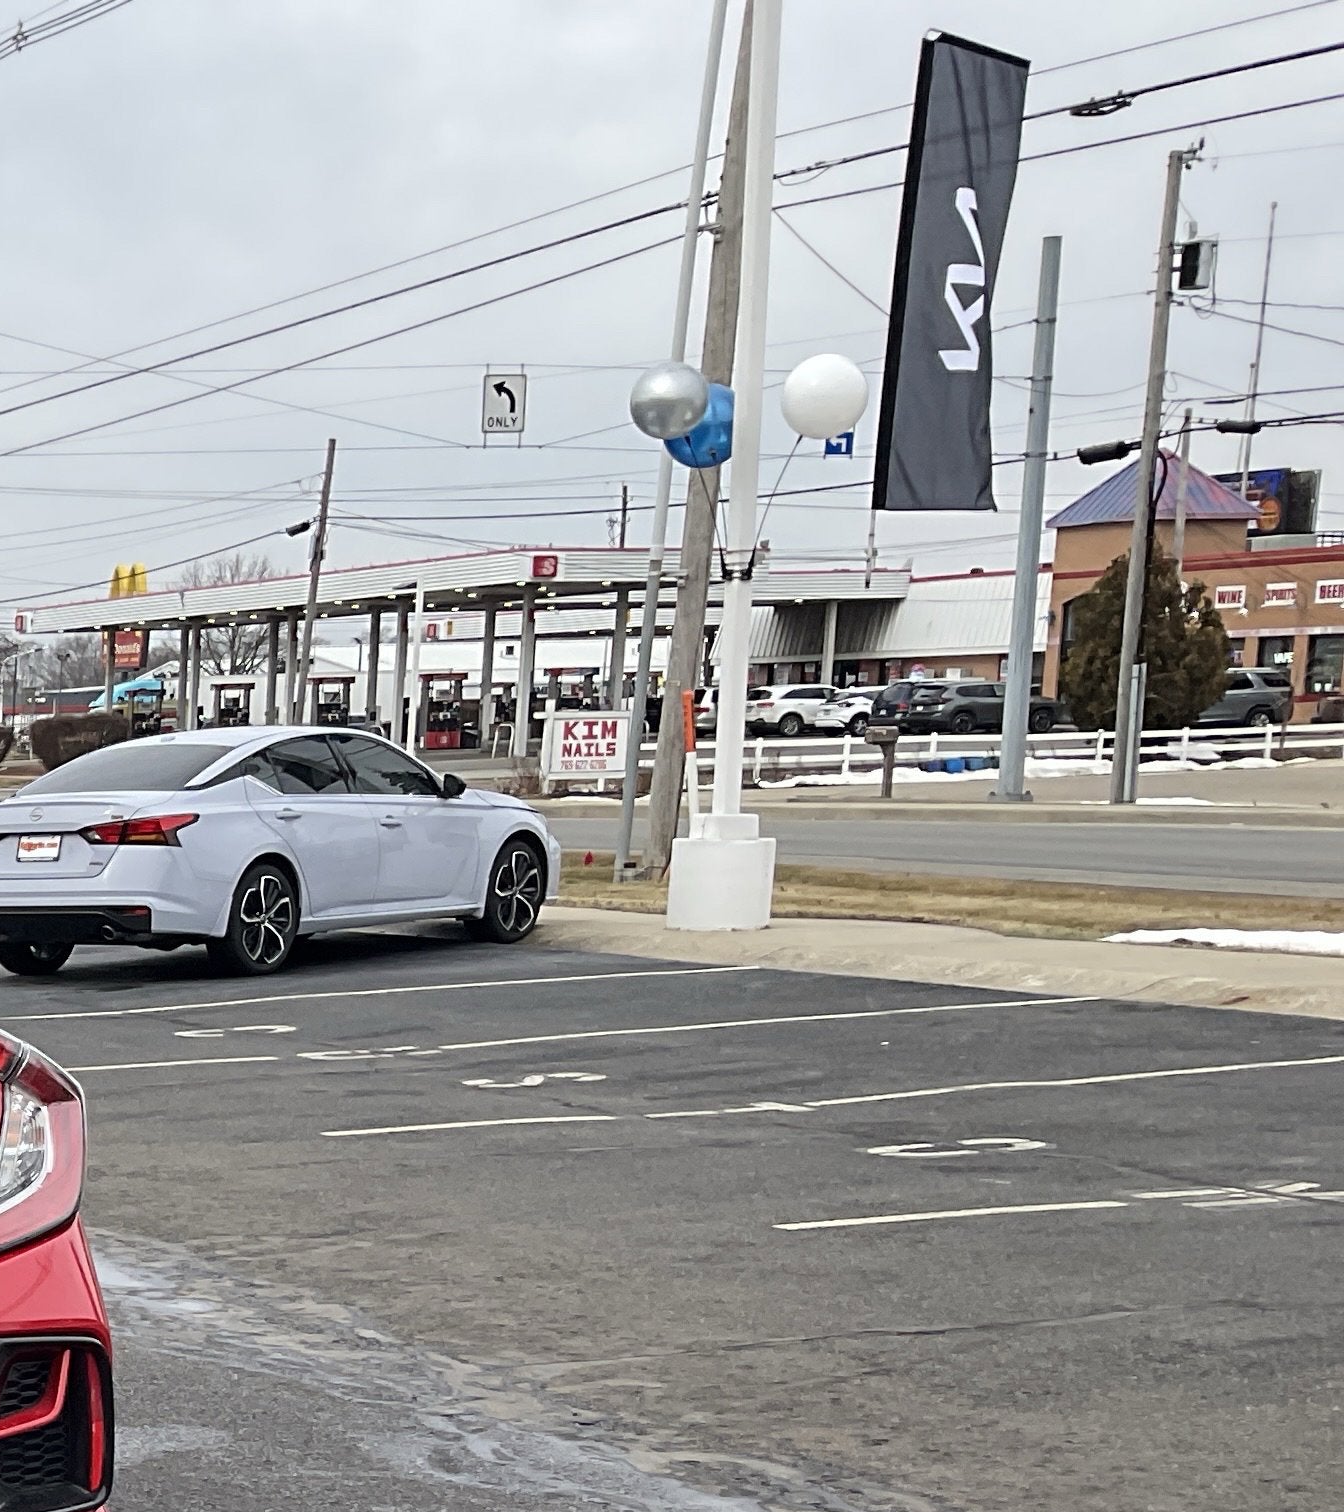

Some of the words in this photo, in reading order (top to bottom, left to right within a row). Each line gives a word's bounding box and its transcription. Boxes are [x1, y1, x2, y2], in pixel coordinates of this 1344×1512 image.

[487, 416, 518, 428] ONLY
[1217, 590, 1243, 604] WINE
[1264, 588, 1297, 601] SPIRITS
[563, 720, 618, 741] KIM
[561, 742, 616, 758] NAILS
